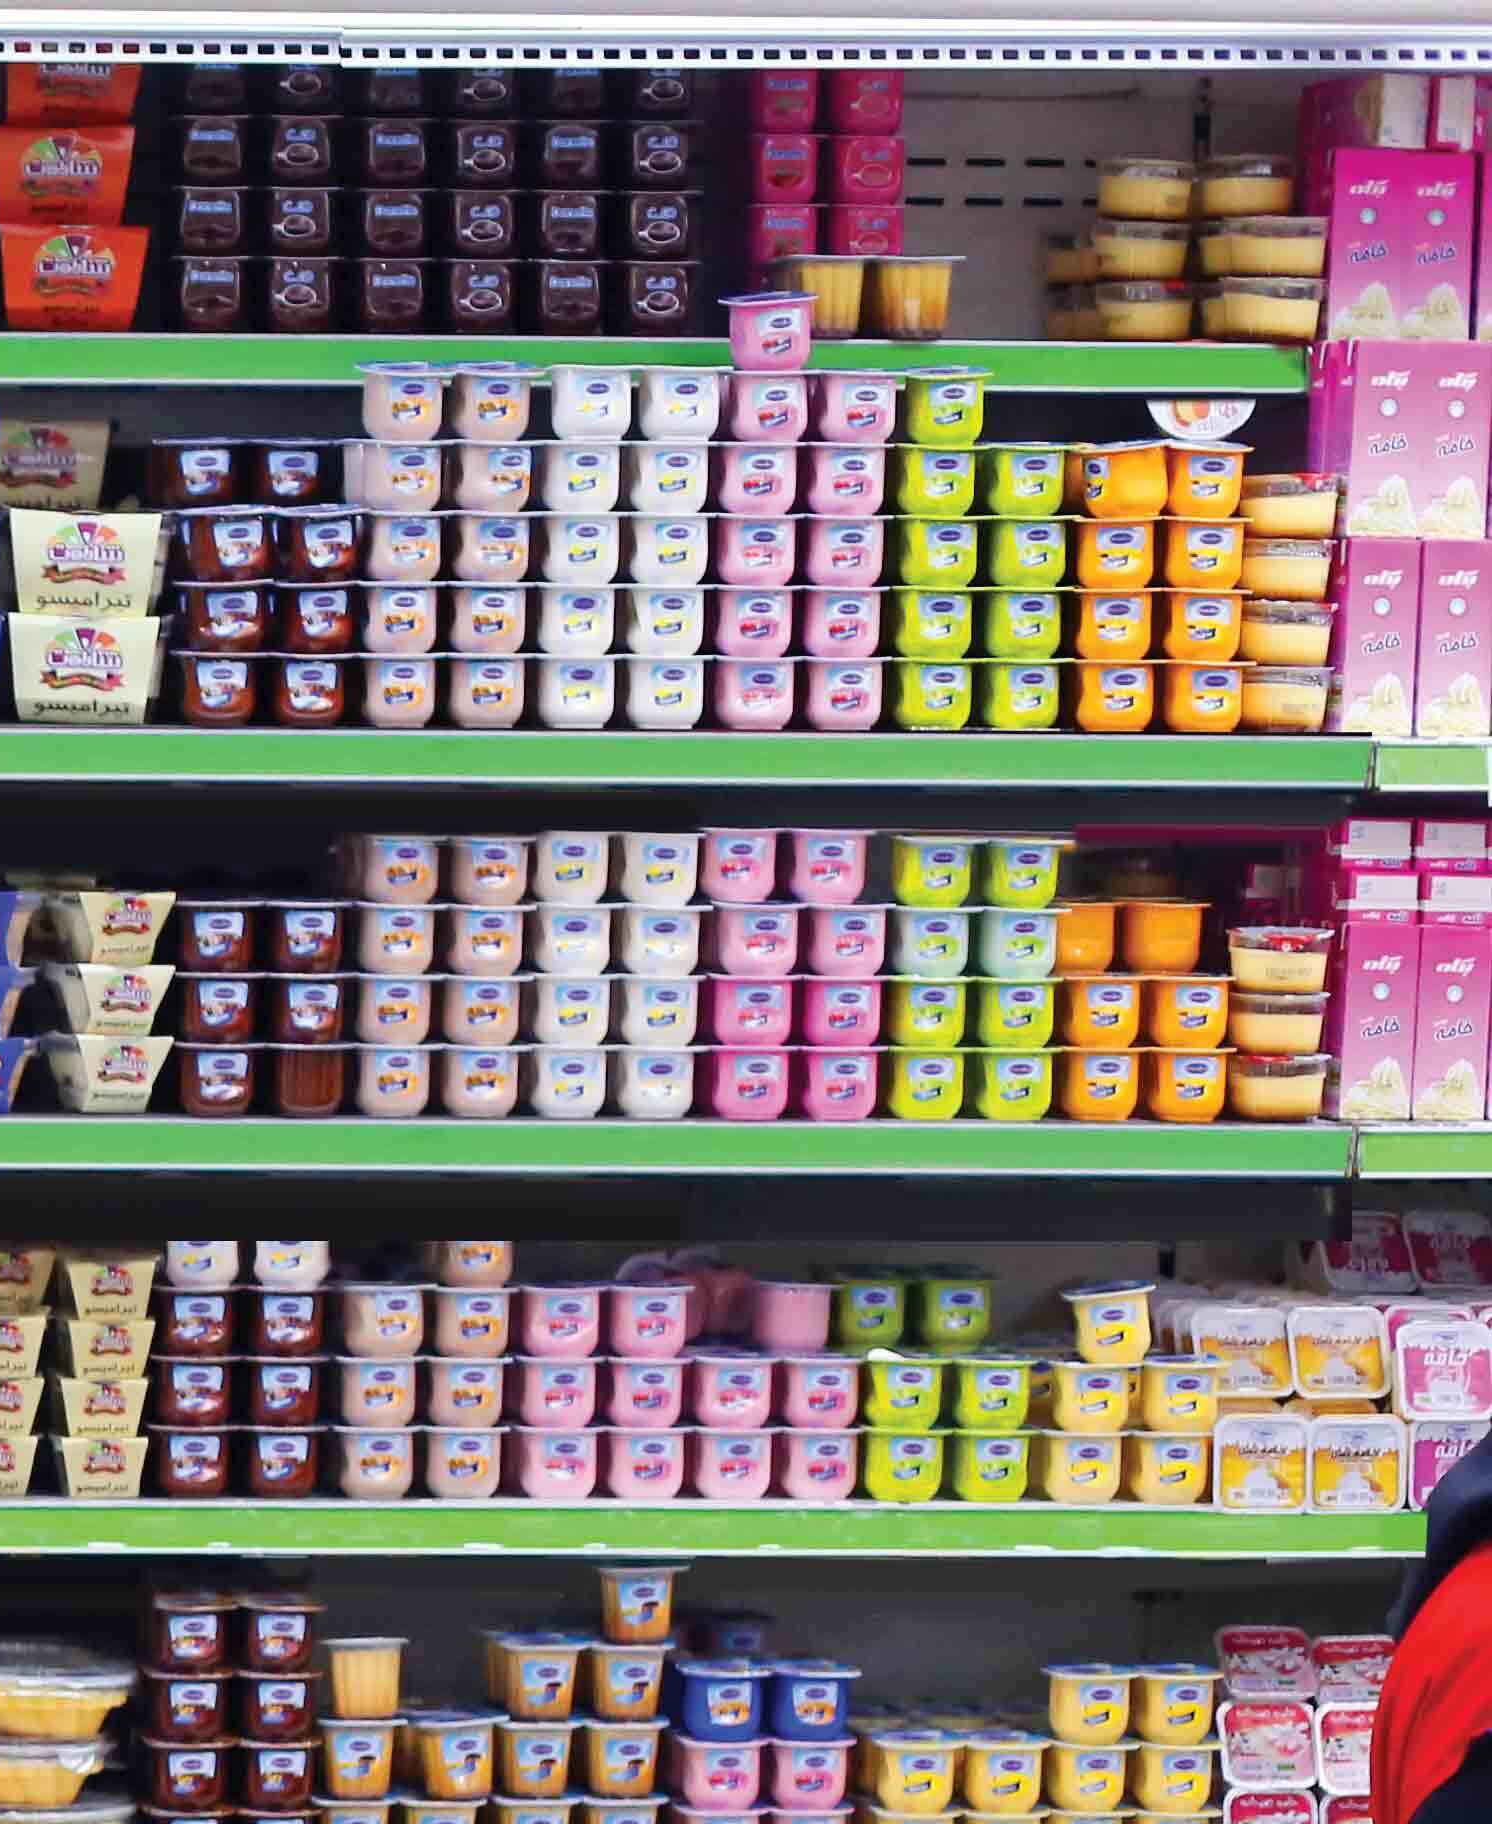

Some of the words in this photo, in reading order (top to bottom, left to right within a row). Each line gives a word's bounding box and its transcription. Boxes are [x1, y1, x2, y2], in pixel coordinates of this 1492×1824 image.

[1349, 243, 1389, 263] خامه
[1416, 243, 1456, 264] خامه
[1368, 435, 1408, 456] خامه
[1436, 436, 1475, 456] خامه
[35, 592, 132, 612] تیرامیسو
[1361, 633, 1401, 655] خامه
[1439, 633, 1479, 655] خامه
[33, 697, 132, 716] تیرامیسو
[1360, 1018, 1401, 1039] خامه
[1433, 1020, 1473, 1040] خامه
[1424, 1349, 1475, 1367] خامه
